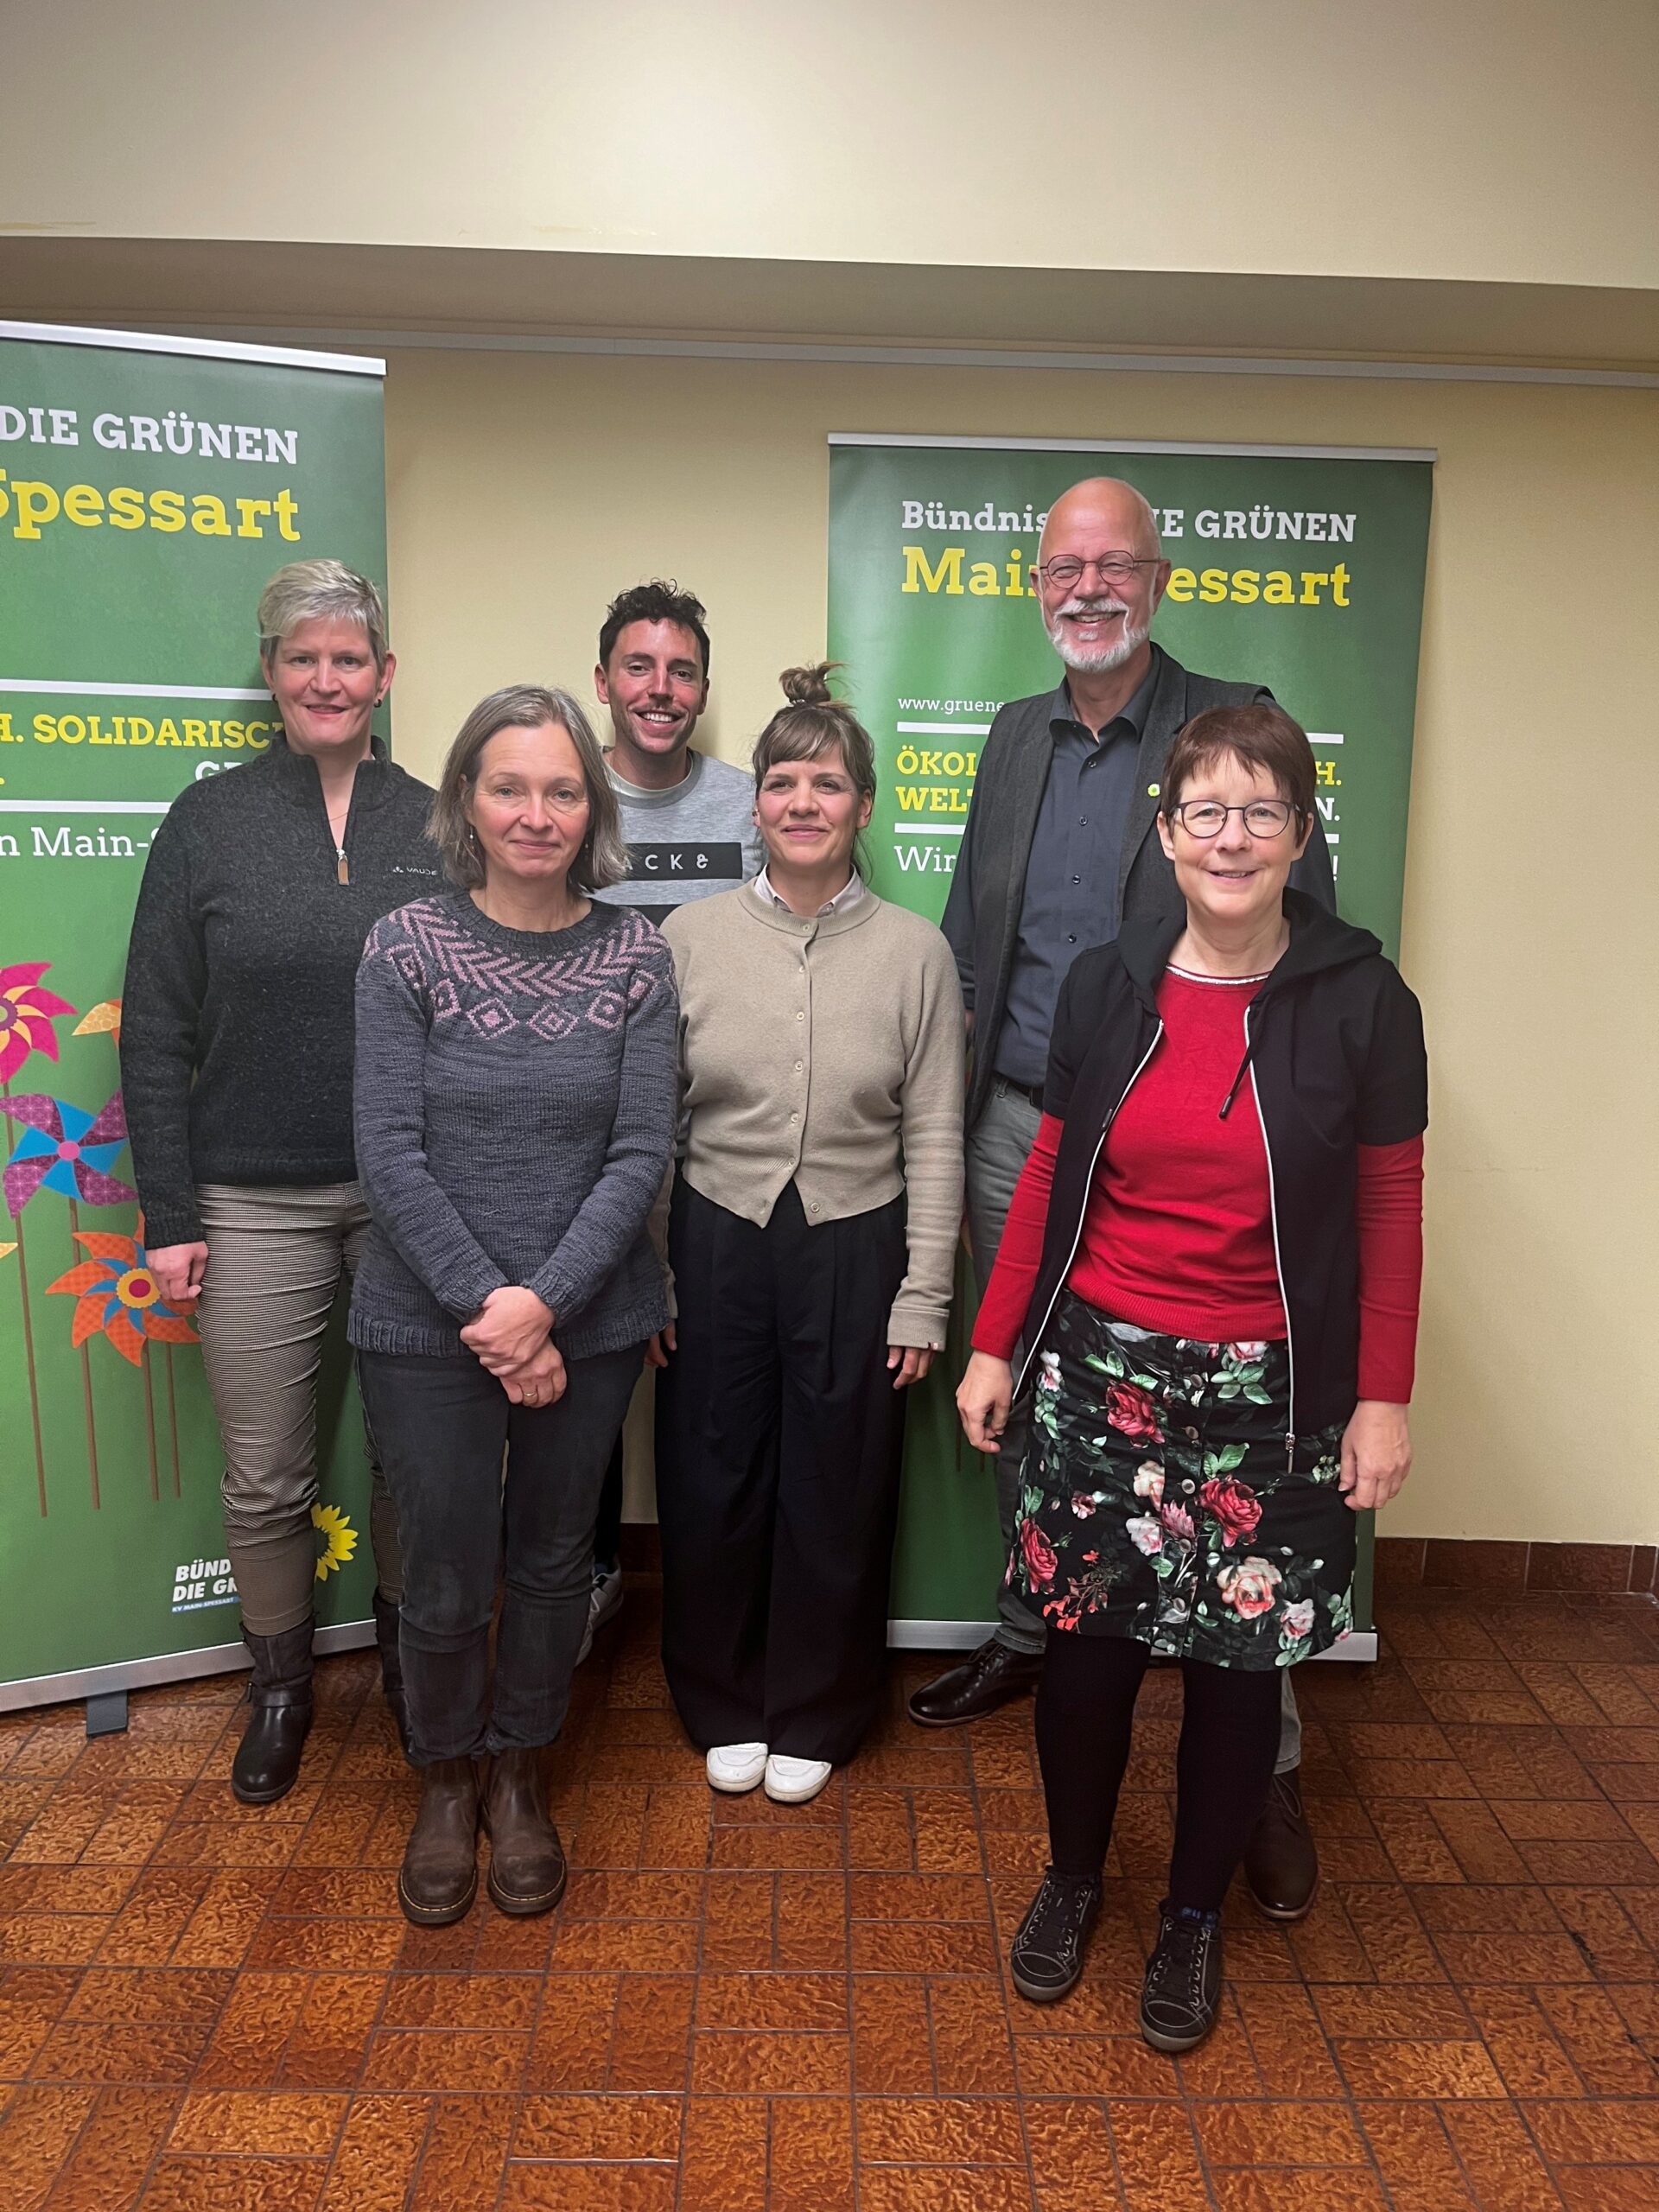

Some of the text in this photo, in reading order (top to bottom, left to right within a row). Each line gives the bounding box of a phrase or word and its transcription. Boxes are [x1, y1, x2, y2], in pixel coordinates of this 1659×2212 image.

[0, 405, 298, 464] DIE GRÜNEN
[0, 468, 301, 541] pessart
[1194, 505, 1357, 543] GRÜNEN
[901, 545, 1039, 597] Mai
[33, 713, 284, 749] SOLIDARISC
[895, 786, 974, 812] WEL
[30, 826, 160, 856] Main-
[893, 845, 957, 873] Wir
[173, 1581, 206, 1602] DIE
